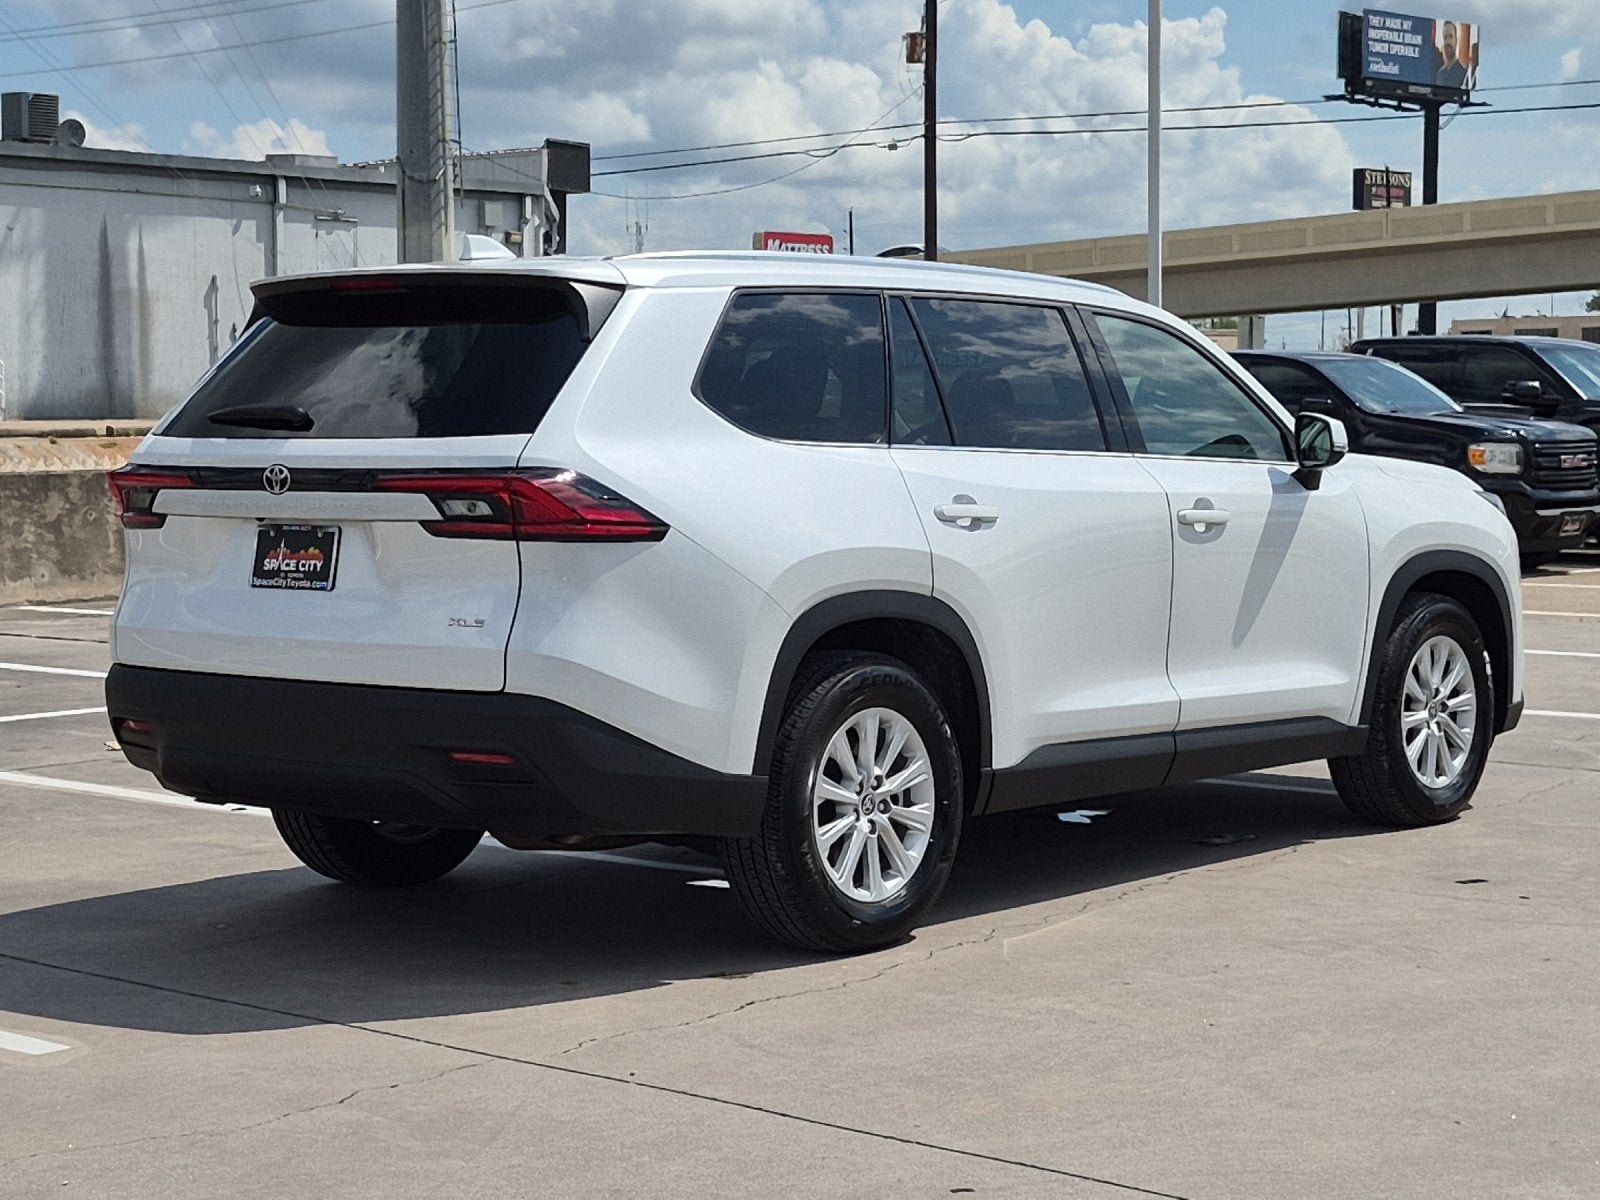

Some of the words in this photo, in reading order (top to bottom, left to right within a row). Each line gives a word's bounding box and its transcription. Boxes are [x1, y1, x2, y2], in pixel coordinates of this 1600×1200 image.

[1368, 15, 1384, 27] THEY
[1385, 17, 1401, 30] MADE
[1402, 20, 1412, 31] MY
[1368, 28, 1403, 43] INOPERABLE
[1404, 33, 1422, 45] BRAIN
[1368, 41, 1388, 54] TUMOR
[1390, 44, 1419, 58] OPERABLE
[767, 239, 831, 255] MATTRESS
[263, 558, 297, 571] SPACE
[298, 560, 324, 572] CITY
